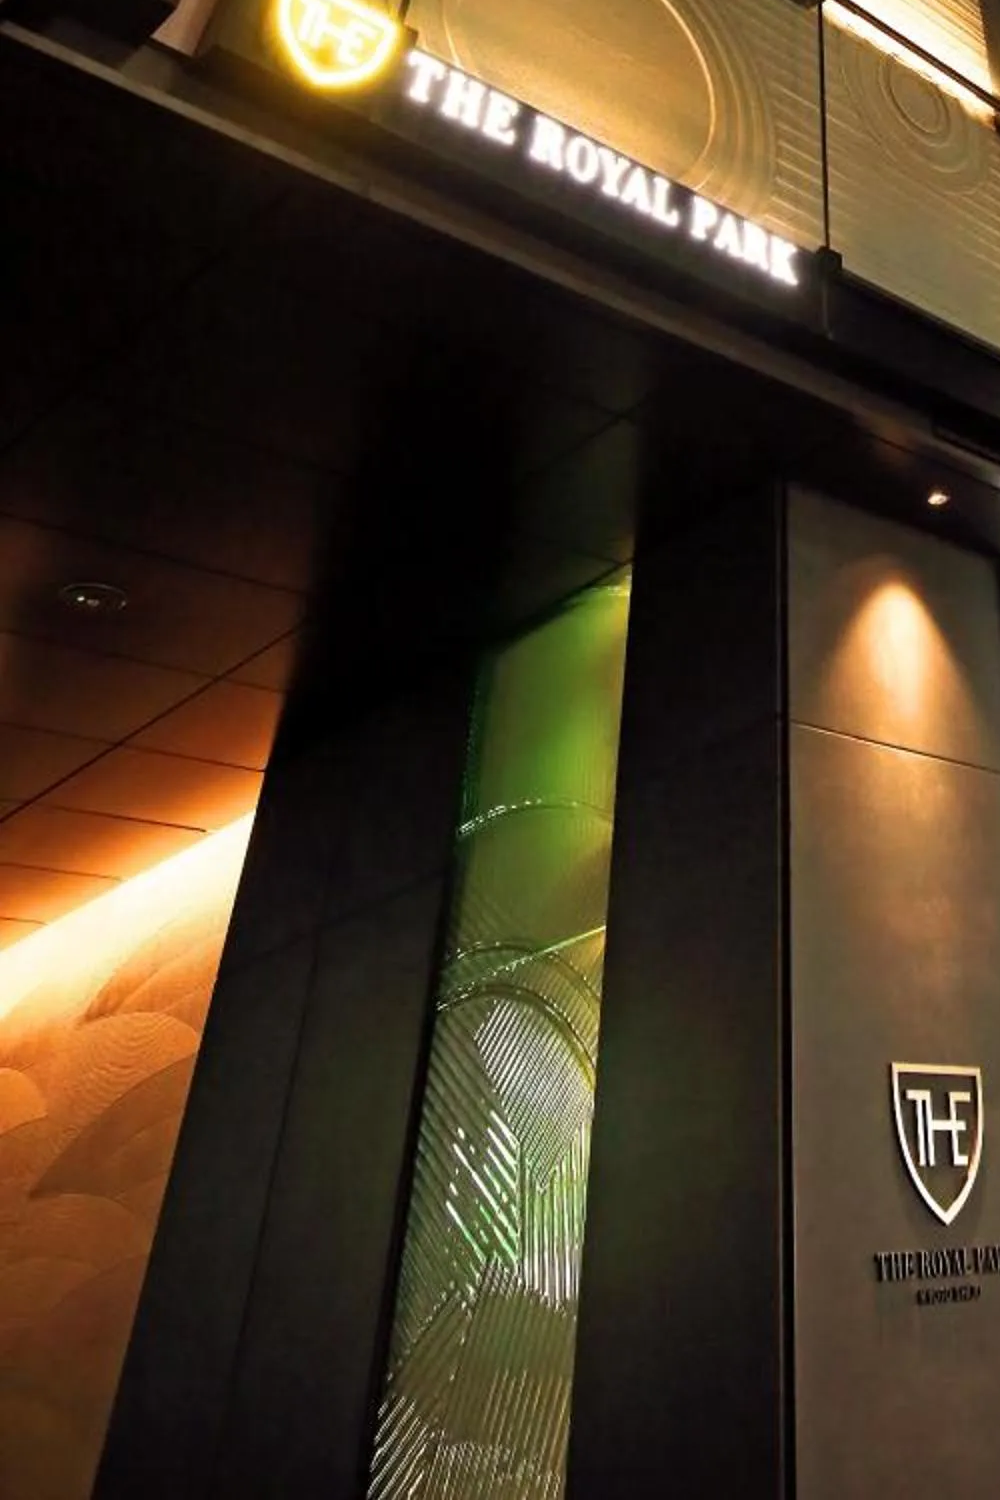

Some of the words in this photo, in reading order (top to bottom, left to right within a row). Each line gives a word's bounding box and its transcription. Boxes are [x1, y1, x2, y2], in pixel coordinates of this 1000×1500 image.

[405, 47, 521, 147] THE
[528, 113, 681, 229] ROYAL
[689, 195, 800, 287] PARK
[905, 1089, 971, 1166] THE
[874, 1251, 915, 1283] THE
[916, 1247, 972, 1280] ROYAL
